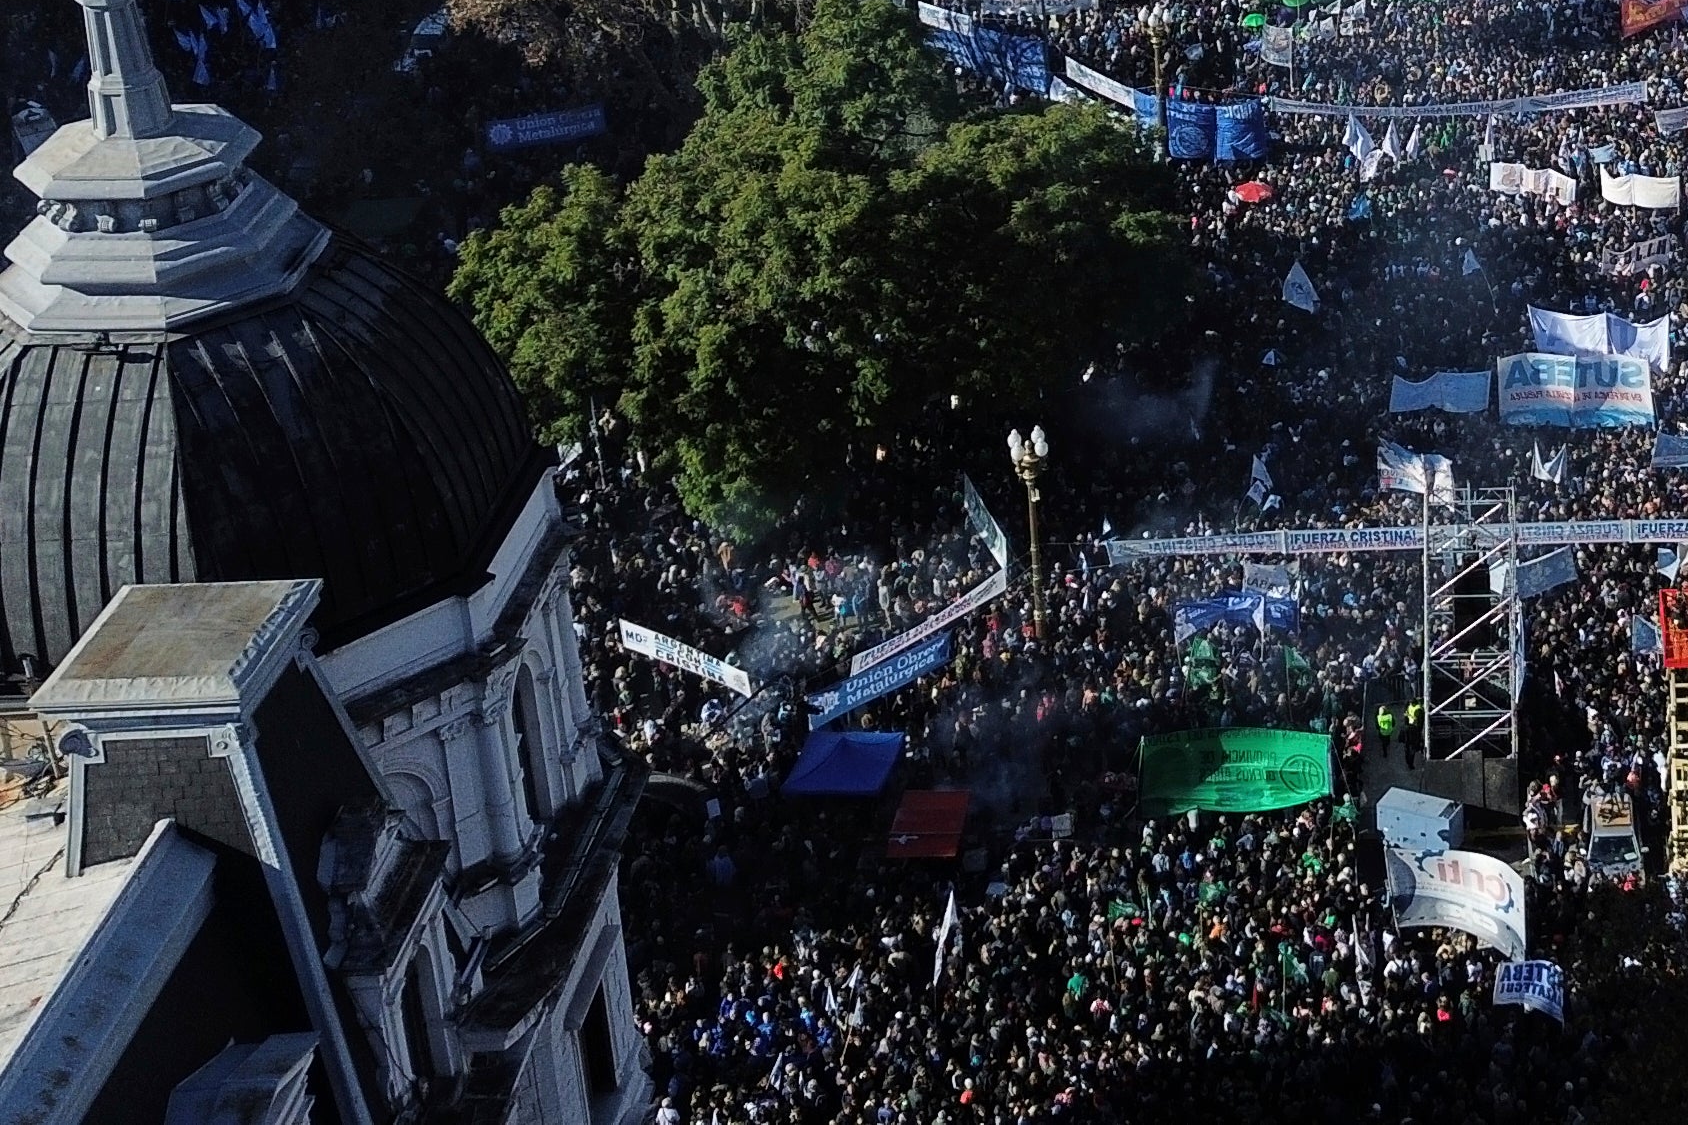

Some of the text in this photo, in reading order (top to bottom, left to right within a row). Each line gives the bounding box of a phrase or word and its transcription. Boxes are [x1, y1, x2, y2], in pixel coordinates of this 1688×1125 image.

[1350, 530, 1417, 543] CRISTINA!
[654, 633, 721, 667] ARGENTINA
[655, 649, 726, 686] CRISTINA
[845, 662, 893, 693] Unión
